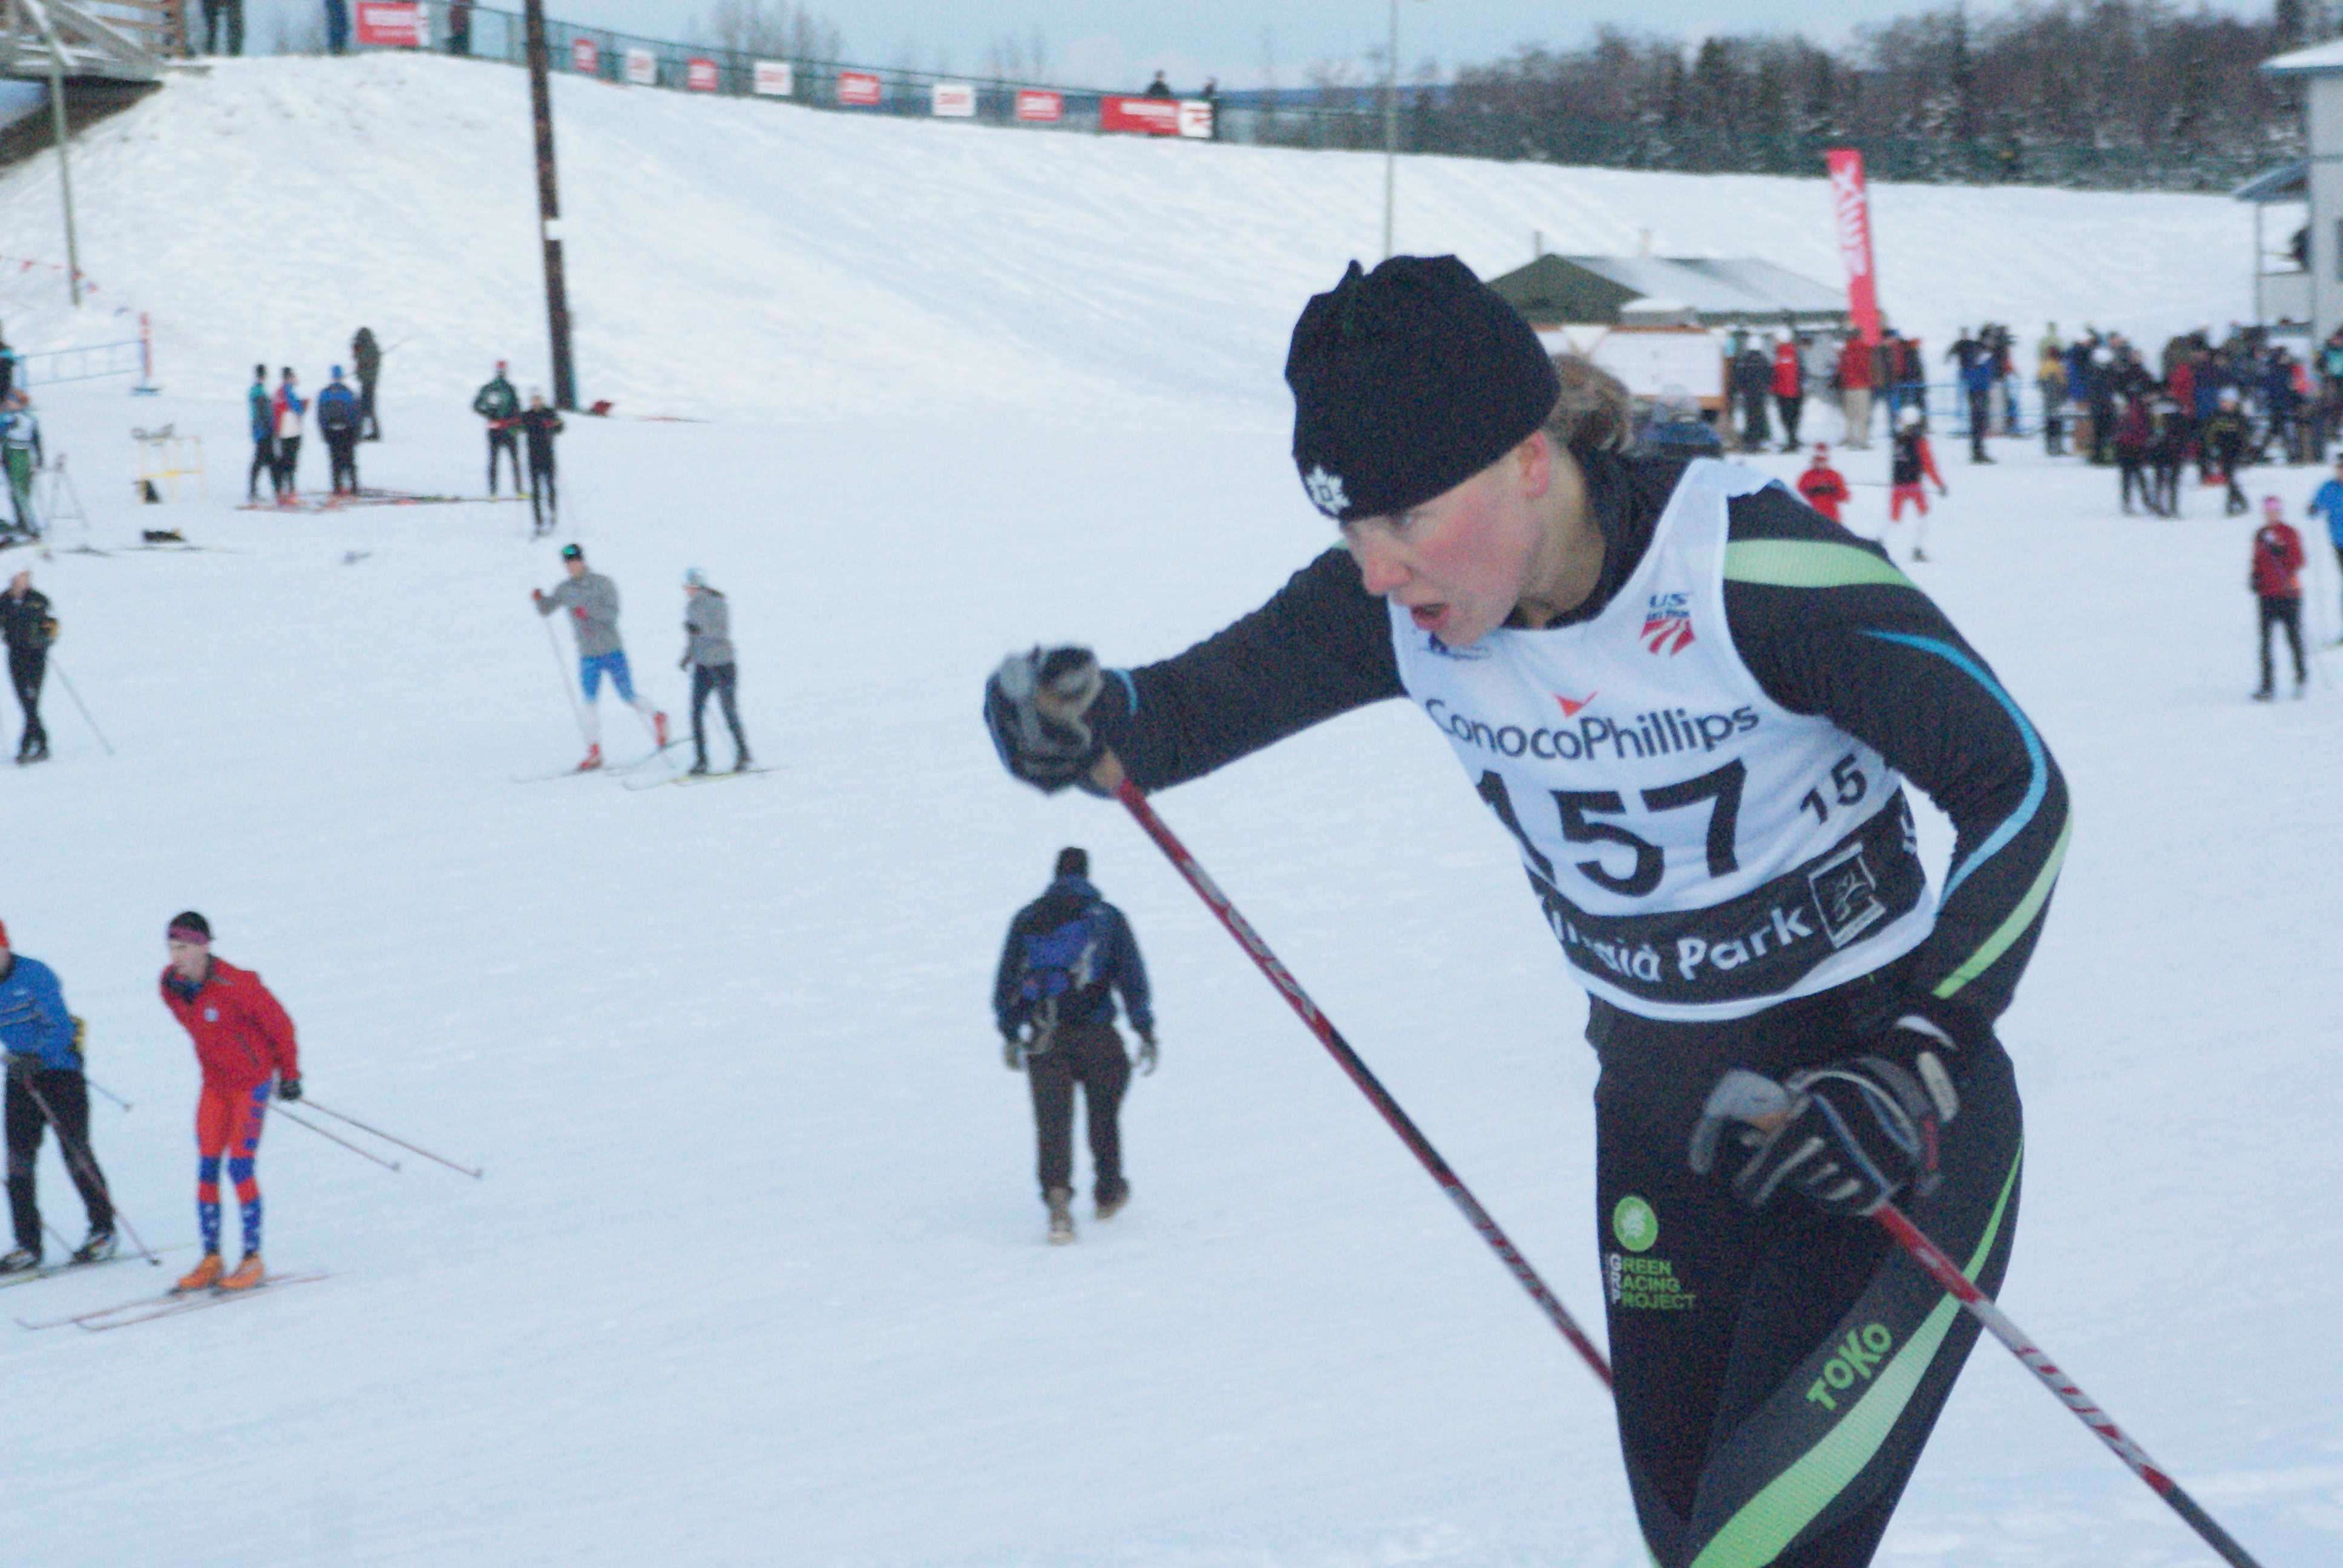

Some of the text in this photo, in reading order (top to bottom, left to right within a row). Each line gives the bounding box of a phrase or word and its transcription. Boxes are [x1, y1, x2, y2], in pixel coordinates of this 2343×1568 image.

[1649, 592, 1687, 607] US
[1425, 697, 1760, 760] ConocoPhillips
[1800, 753, 1867, 825] 15
[1475, 757, 1748, 898] 157
[1677, 906, 1814, 981] Park
[1610, 1253, 1672, 1276] GREEN
[1610, 1272, 1682, 1292] RACING
[1611, 1289, 1696, 1310] PROJECT
[1806, 1323, 1892, 1410] TOKO
